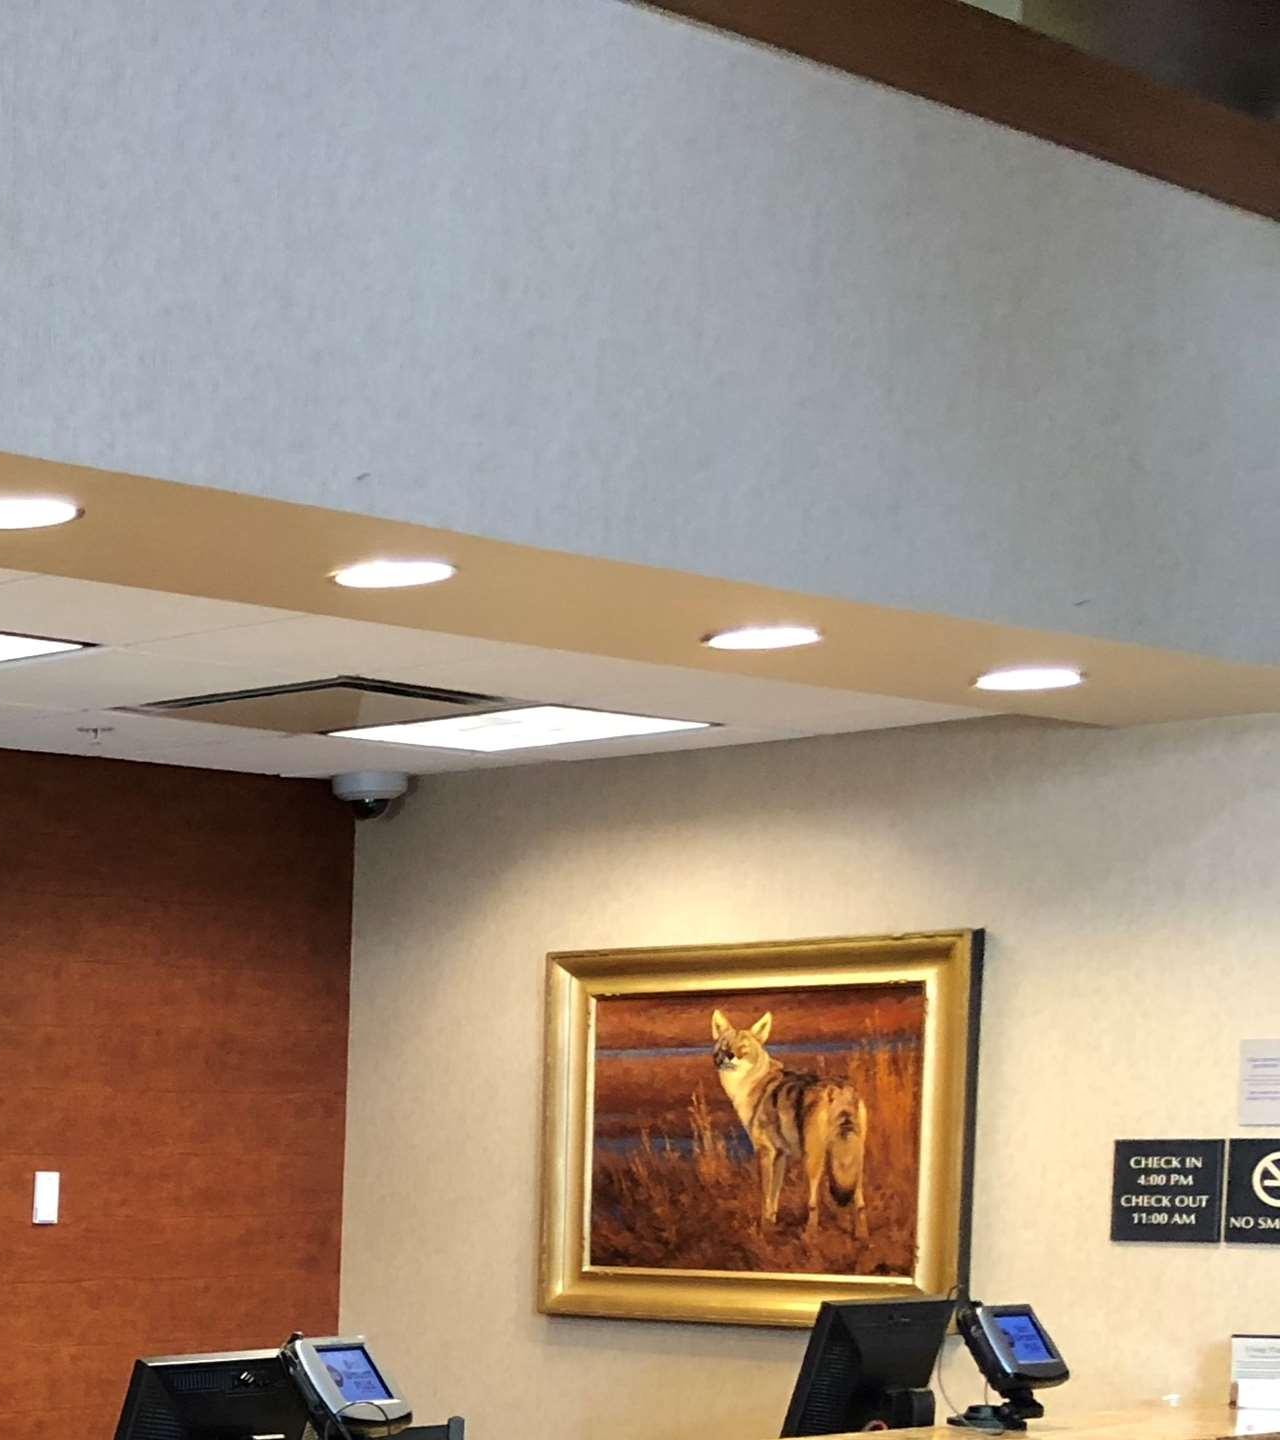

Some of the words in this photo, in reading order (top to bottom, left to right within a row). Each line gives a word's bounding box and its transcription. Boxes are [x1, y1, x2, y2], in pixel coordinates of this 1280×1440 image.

[1130, 1156, 1182, 1169] CHECK
[1185, 1156, 1203, 1169] IN
[1170, 1173, 1194, 1186] PM
[1120, 1194, 1172, 1208] CHECK
[1175, 1194, 1209, 1208] OUT
[1132, 1212, 1168, 1225] 11:00
[1171, 1212, 1197, 1225] AM
[1229, 1216, 1254, 1229] NO
